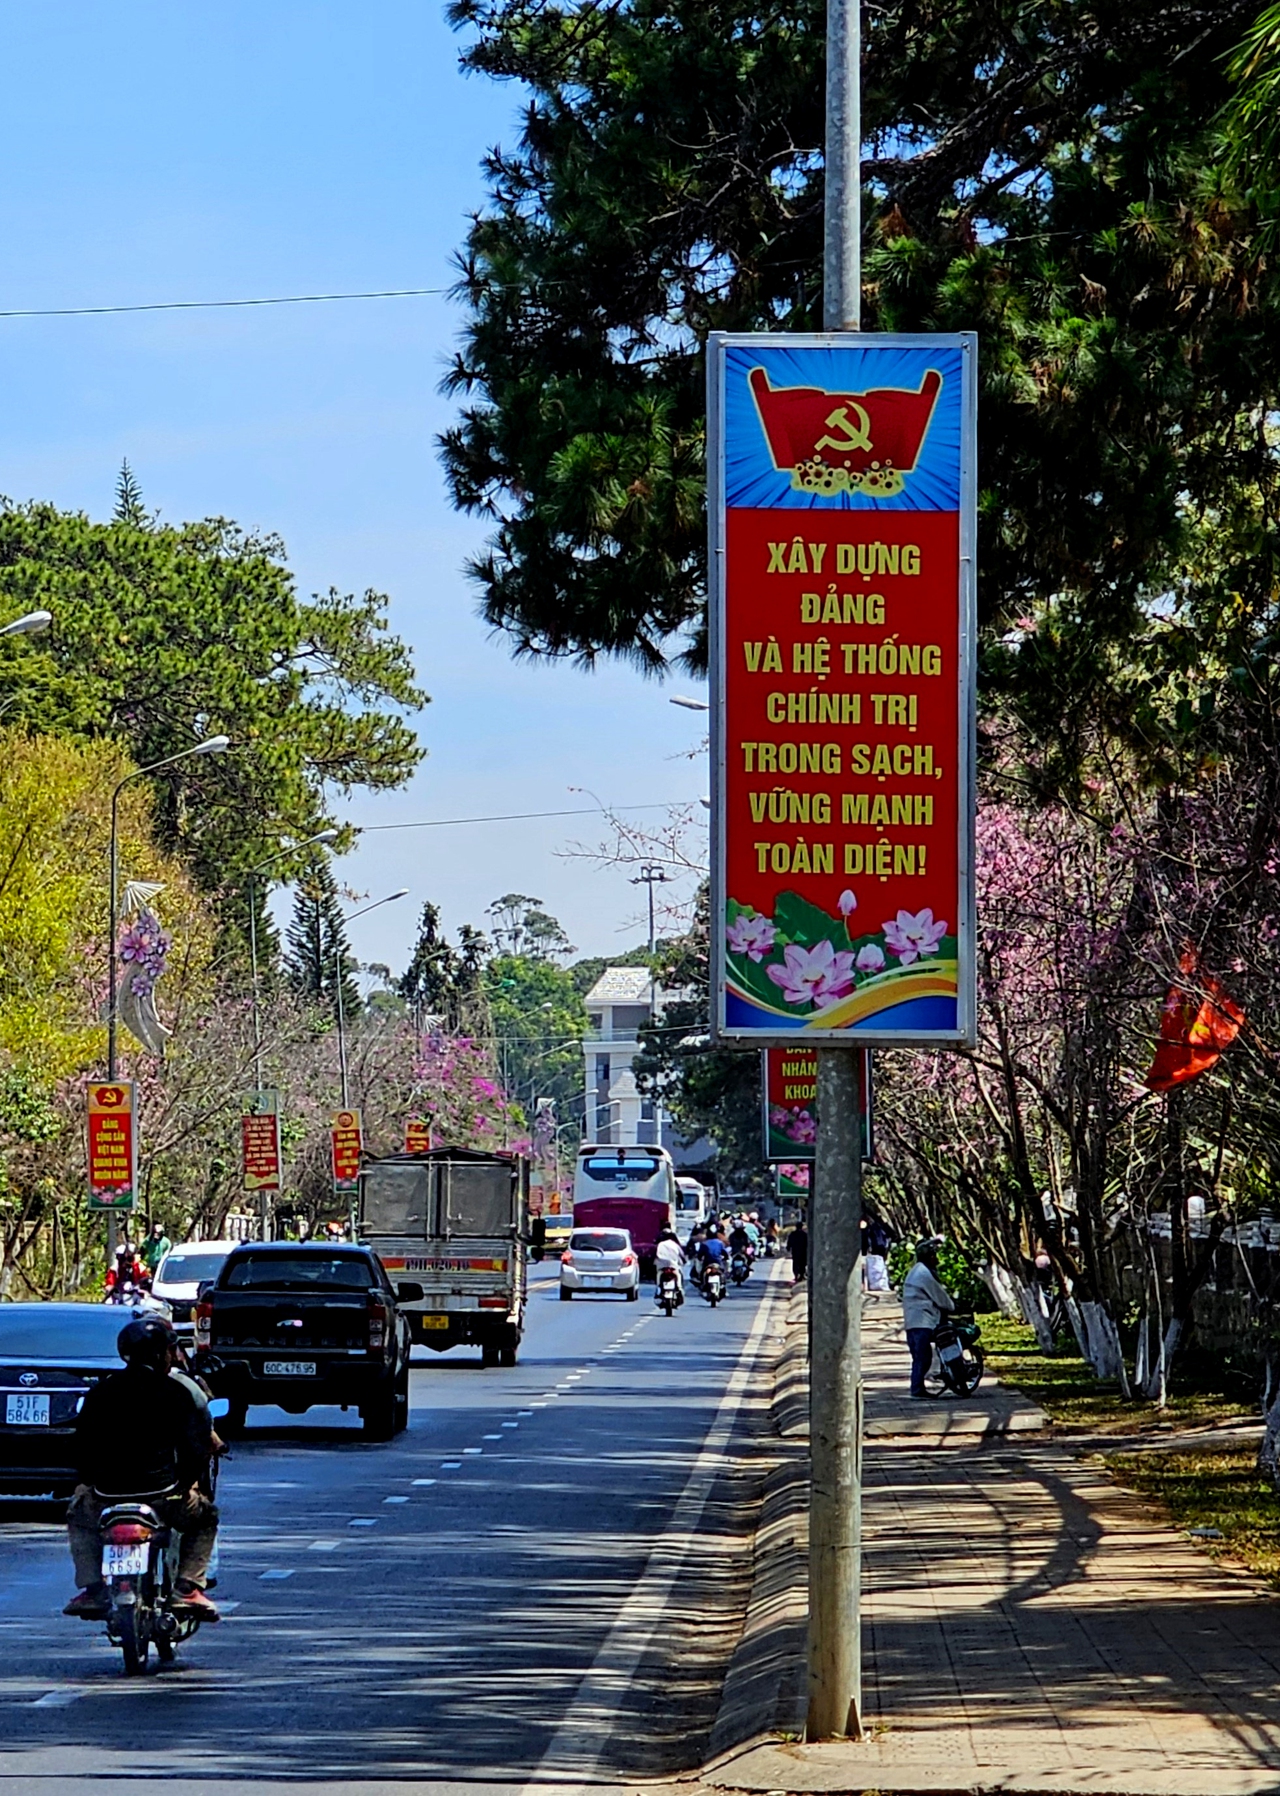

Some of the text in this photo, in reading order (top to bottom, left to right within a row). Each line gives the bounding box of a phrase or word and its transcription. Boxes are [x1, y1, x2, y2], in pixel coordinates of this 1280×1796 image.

[767, 536, 921, 581] XÂY DỰNG
[800, 584, 885, 625] ĐẢNG
[743, 633, 942, 680] VÀ HỆ THỐNG
[767, 687, 917, 732] CHÍNH TRỊ
[741, 742, 942, 781] TRONG SẠCH,
[749, 787, 933, 831] VỮNG MẠNH
[754, 837, 926, 882] TOÀN DIỆN!
[782, 1059, 817, 1077] NHÂN
[17, 1396, 40, 1409] 51F
[109, 1560, 142, 1574] 6659
